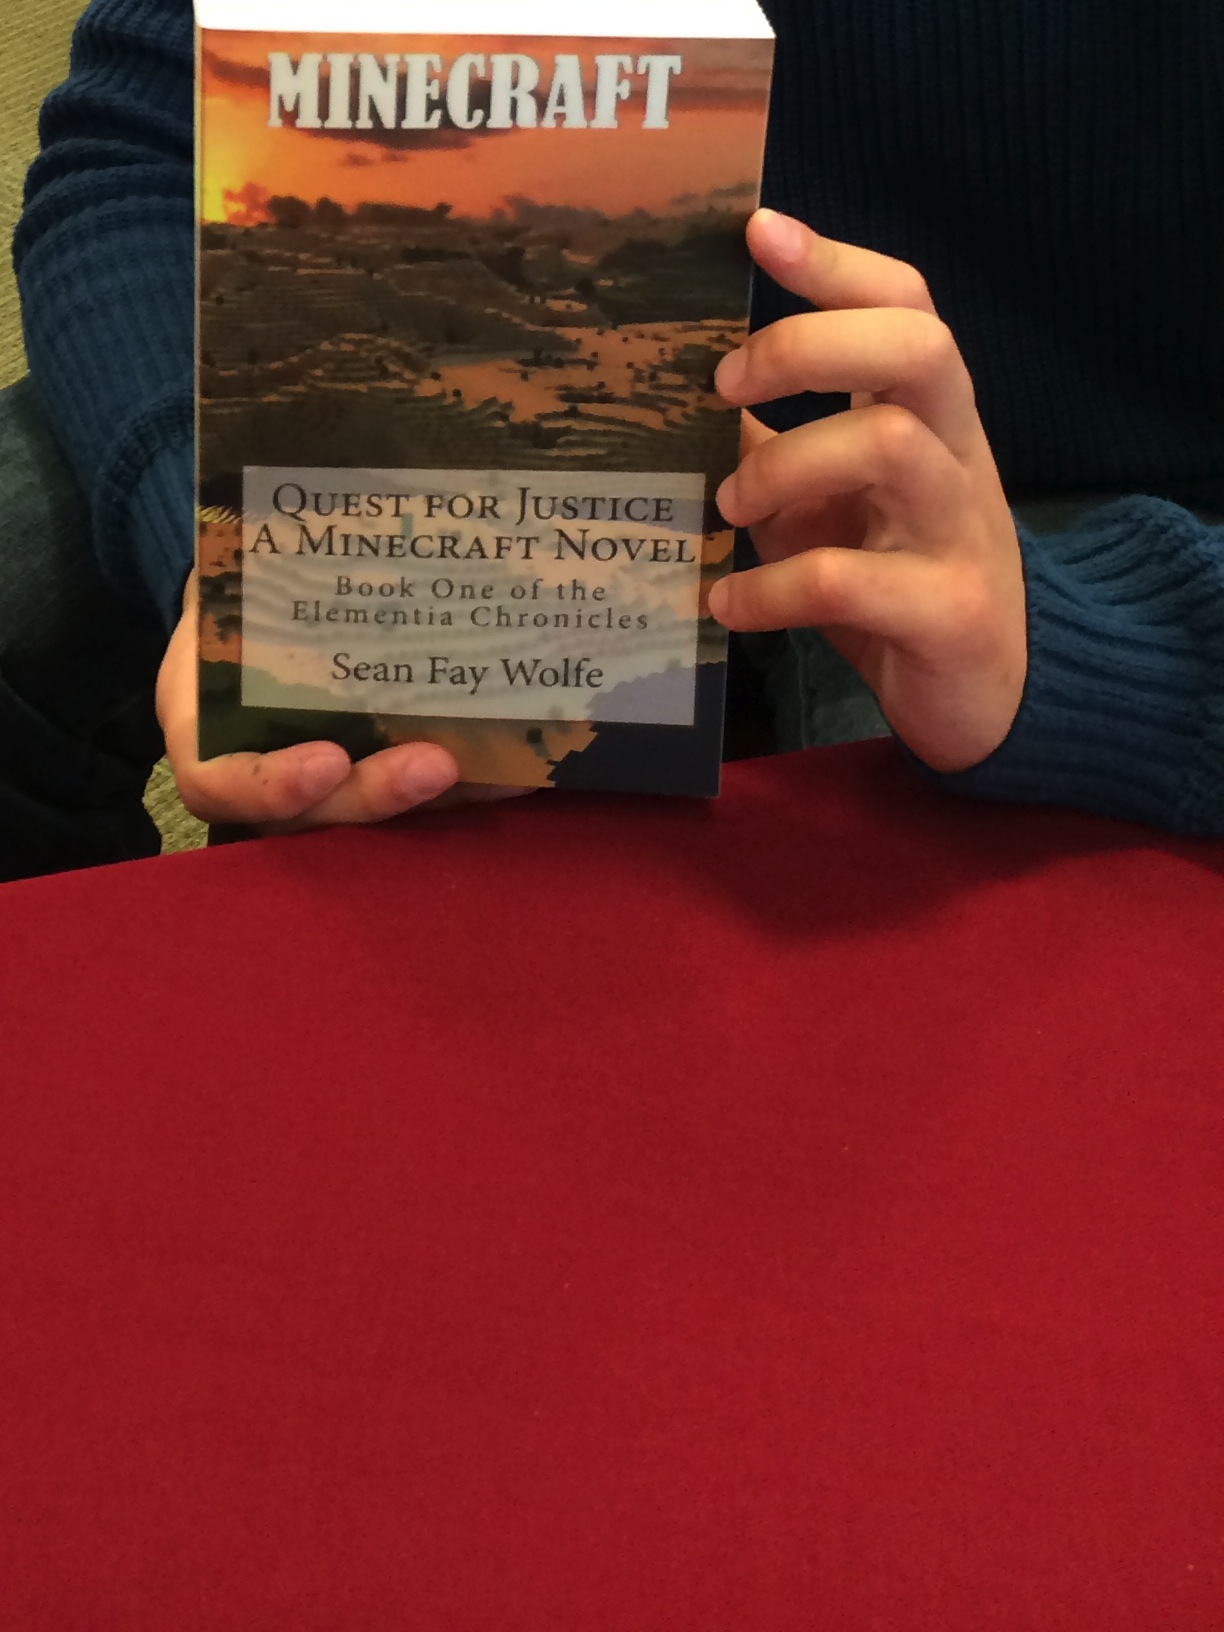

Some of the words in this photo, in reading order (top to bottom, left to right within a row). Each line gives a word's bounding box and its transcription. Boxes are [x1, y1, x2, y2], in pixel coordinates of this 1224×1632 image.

[267, 52, 682, 130] MINECRAFT
[273, 482, 412, 521] QUEST
[516, 486, 675, 525] JUSTICE
[249, 523, 281, 555] A
[296, 523, 539, 561] MINECRAFT
[553, 528, 697, 564] NOVEL
[334, 575, 416, 599] Book
[431, 577, 495, 601] One
[510, 577, 544, 601] of
[556, 578, 607, 602] the
[291, 599, 455, 627] Elementia
[470, 605, 650, 630] Chronicles
[330, 651, 414, 684] Sean
[428, 656, 489, 695] Fay
[499, 657, 606, 689] Wolfe
